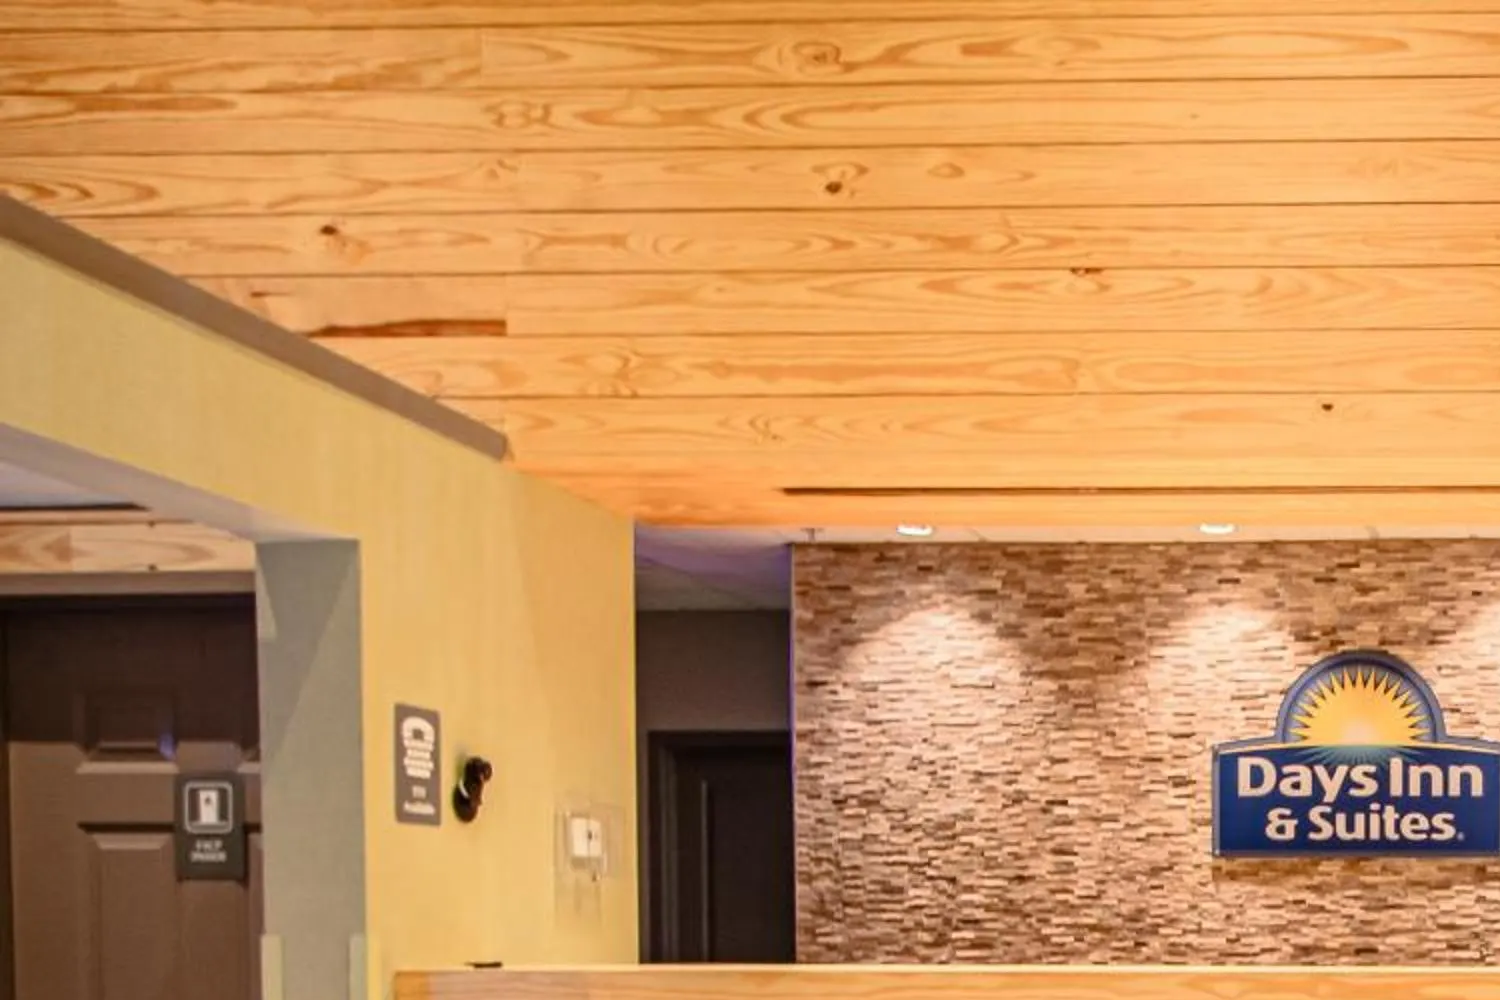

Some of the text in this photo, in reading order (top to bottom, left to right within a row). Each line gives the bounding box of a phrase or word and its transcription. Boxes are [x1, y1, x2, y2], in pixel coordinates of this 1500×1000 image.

[1237, 756, 1484, 802] Days Inn
[1265, 803, 1456, 841] & Suites
